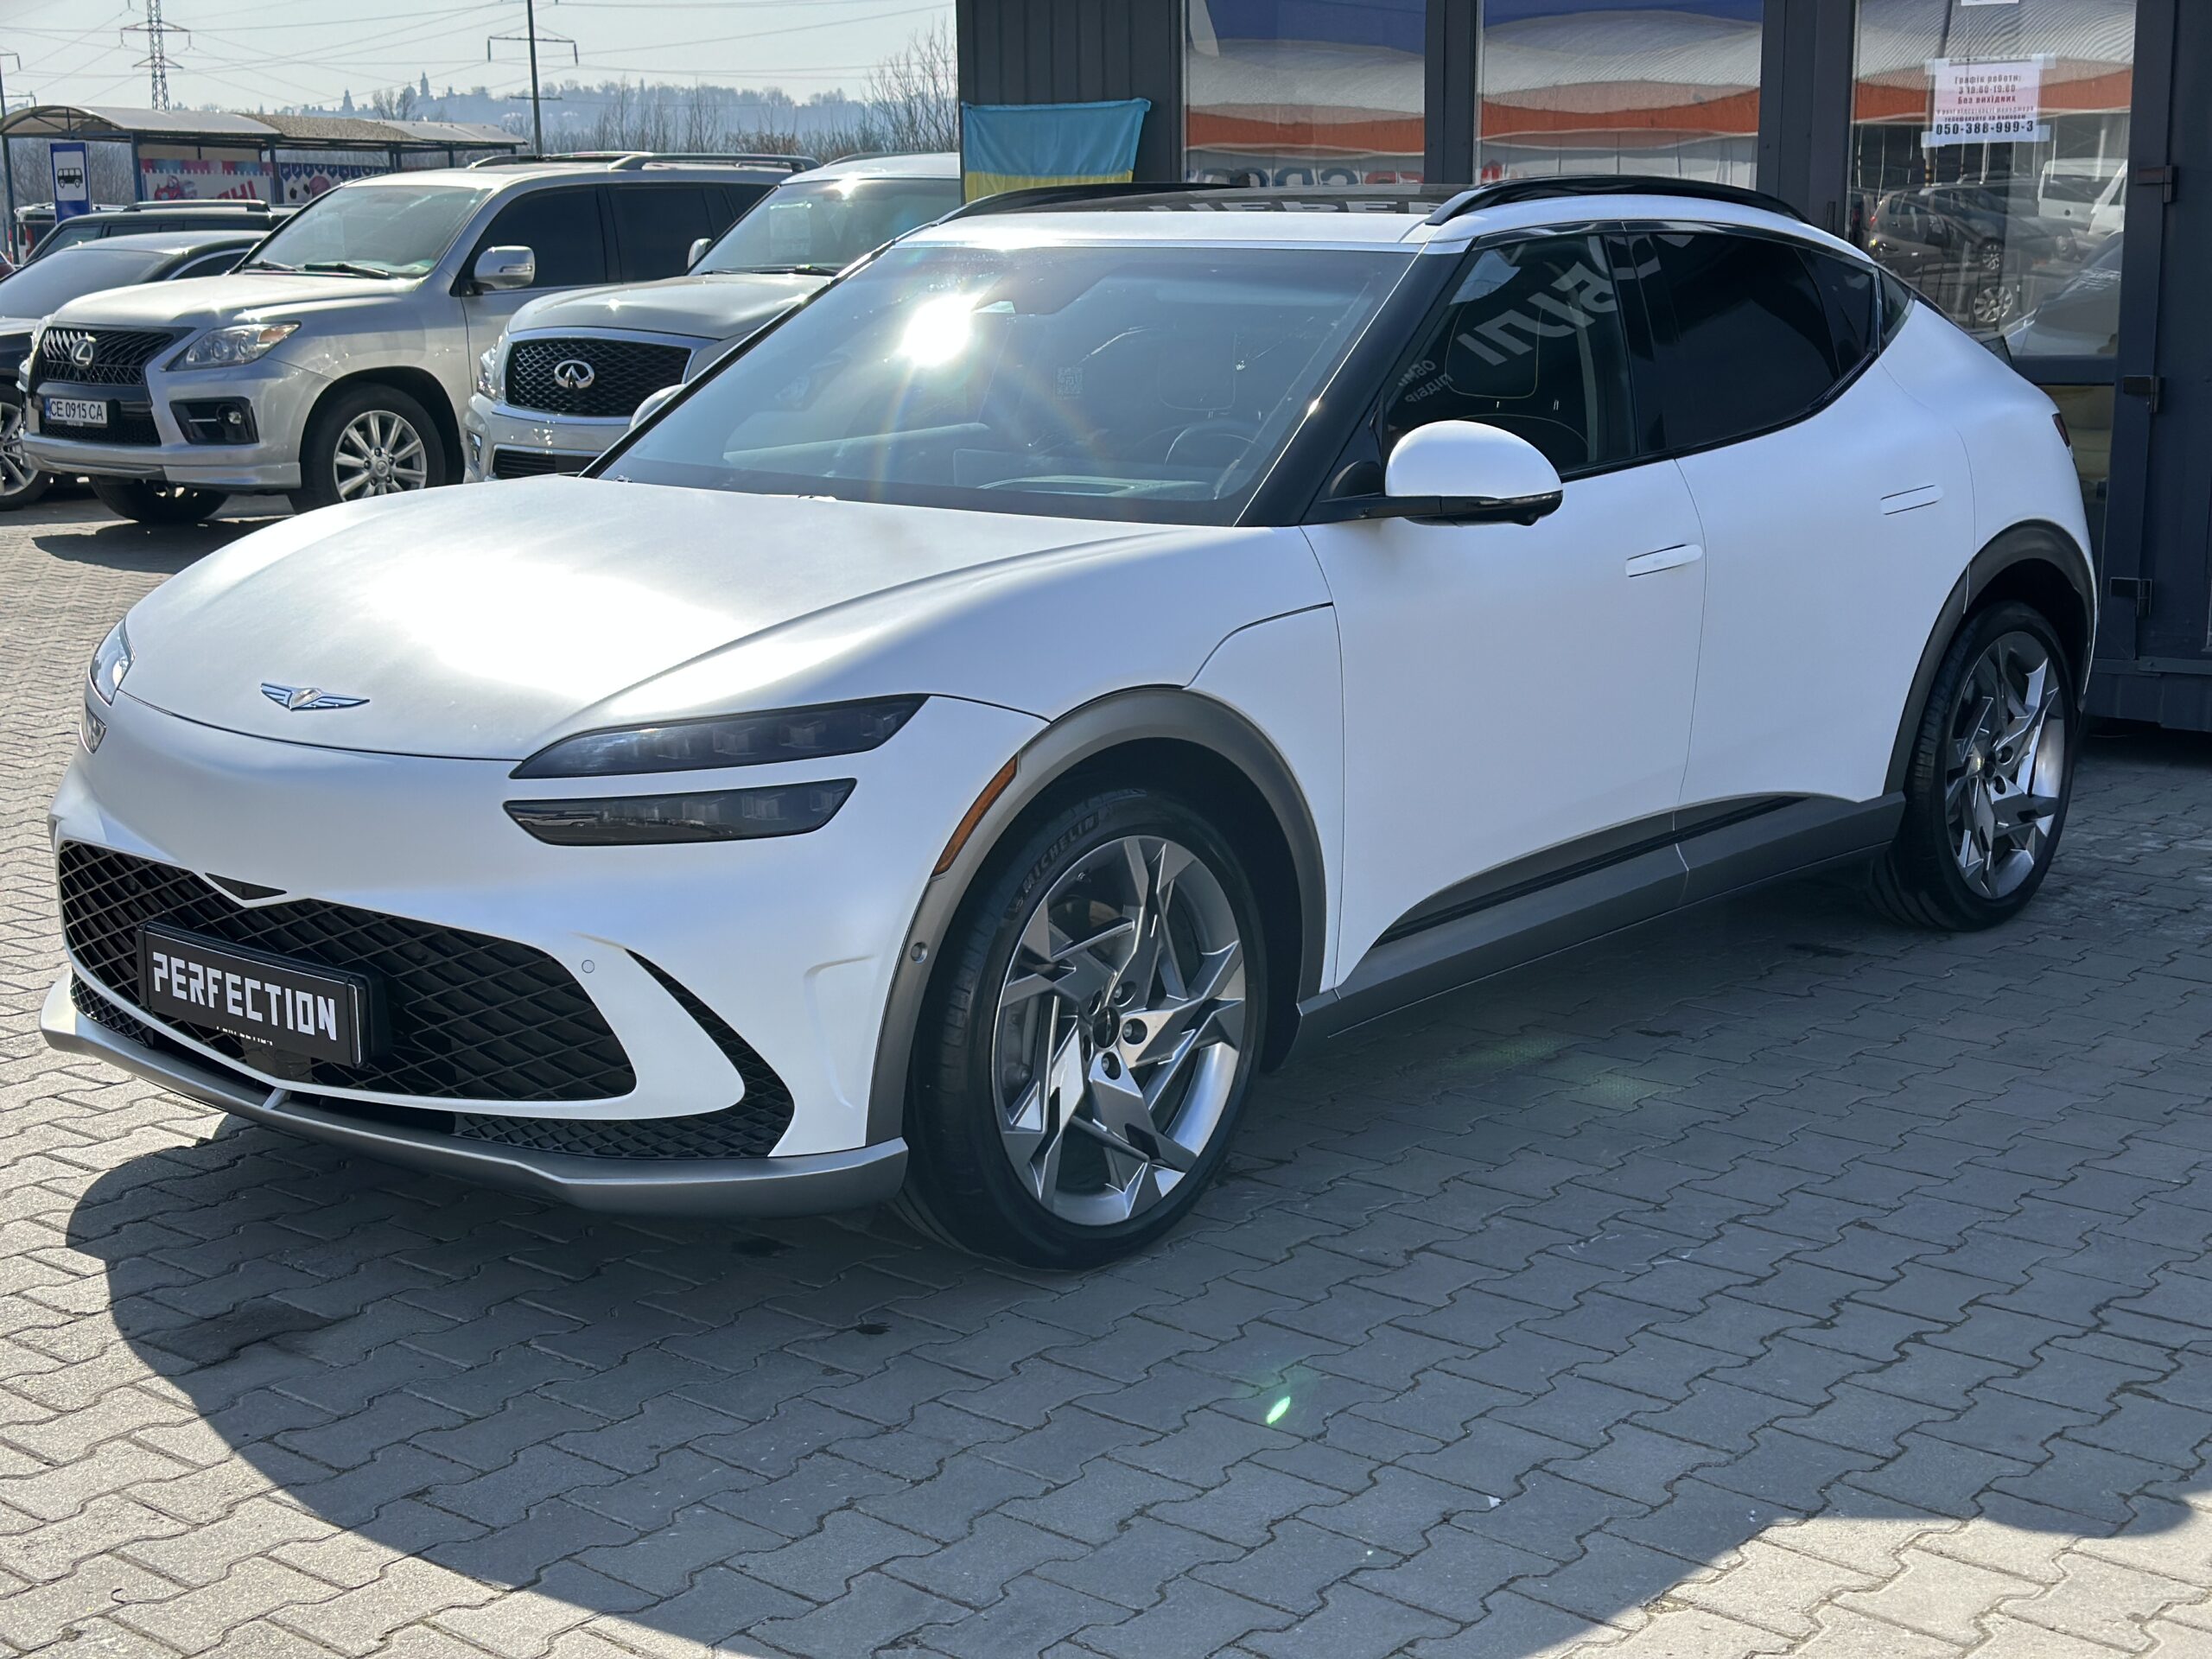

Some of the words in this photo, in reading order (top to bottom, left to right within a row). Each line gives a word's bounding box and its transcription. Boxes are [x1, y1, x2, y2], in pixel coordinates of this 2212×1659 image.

[1936, 120, 2034, 135] 050-388-999-3
[51, 400, 63, 416] CE
[66, 402, 86, 419] 0915
[89, 404, 104, 420] CA
[1022, 813, 1096, 894] MICHELIN
[153, 951, 337, 1041] PERFECTION
